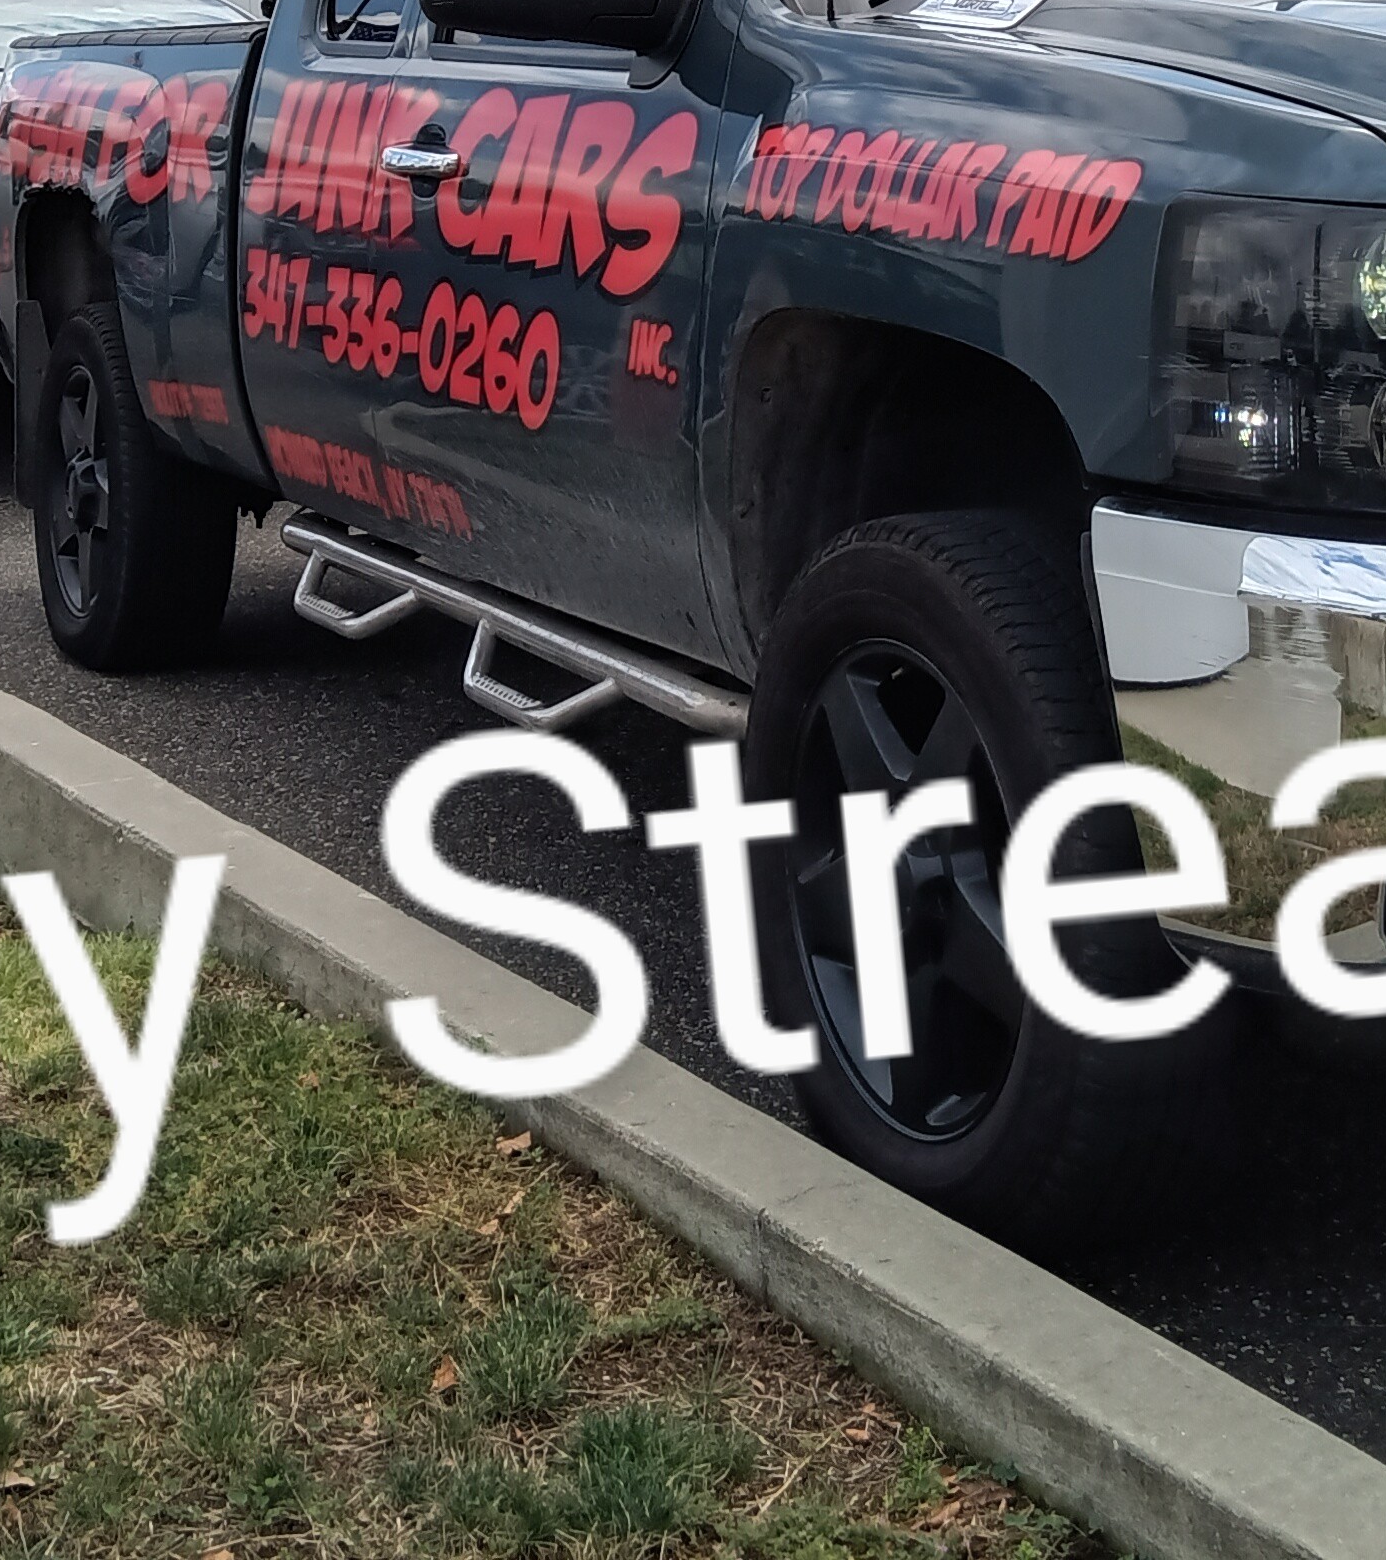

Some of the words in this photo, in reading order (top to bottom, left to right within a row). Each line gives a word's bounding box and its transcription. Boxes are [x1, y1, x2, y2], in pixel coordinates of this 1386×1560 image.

[92, 75, 229, 205] FOR
[244, 80, 439, 241] JUNK
[435, 87, 699, 297] CARS
[743, 122, 837, 223] TOP
[813, 128, 1008, 243] DOLLAR
[984, 148, 1143, 263] PAID
[243, 247, 561, 431] 347-336-0260
[626, 318, 678, 385] INC.
